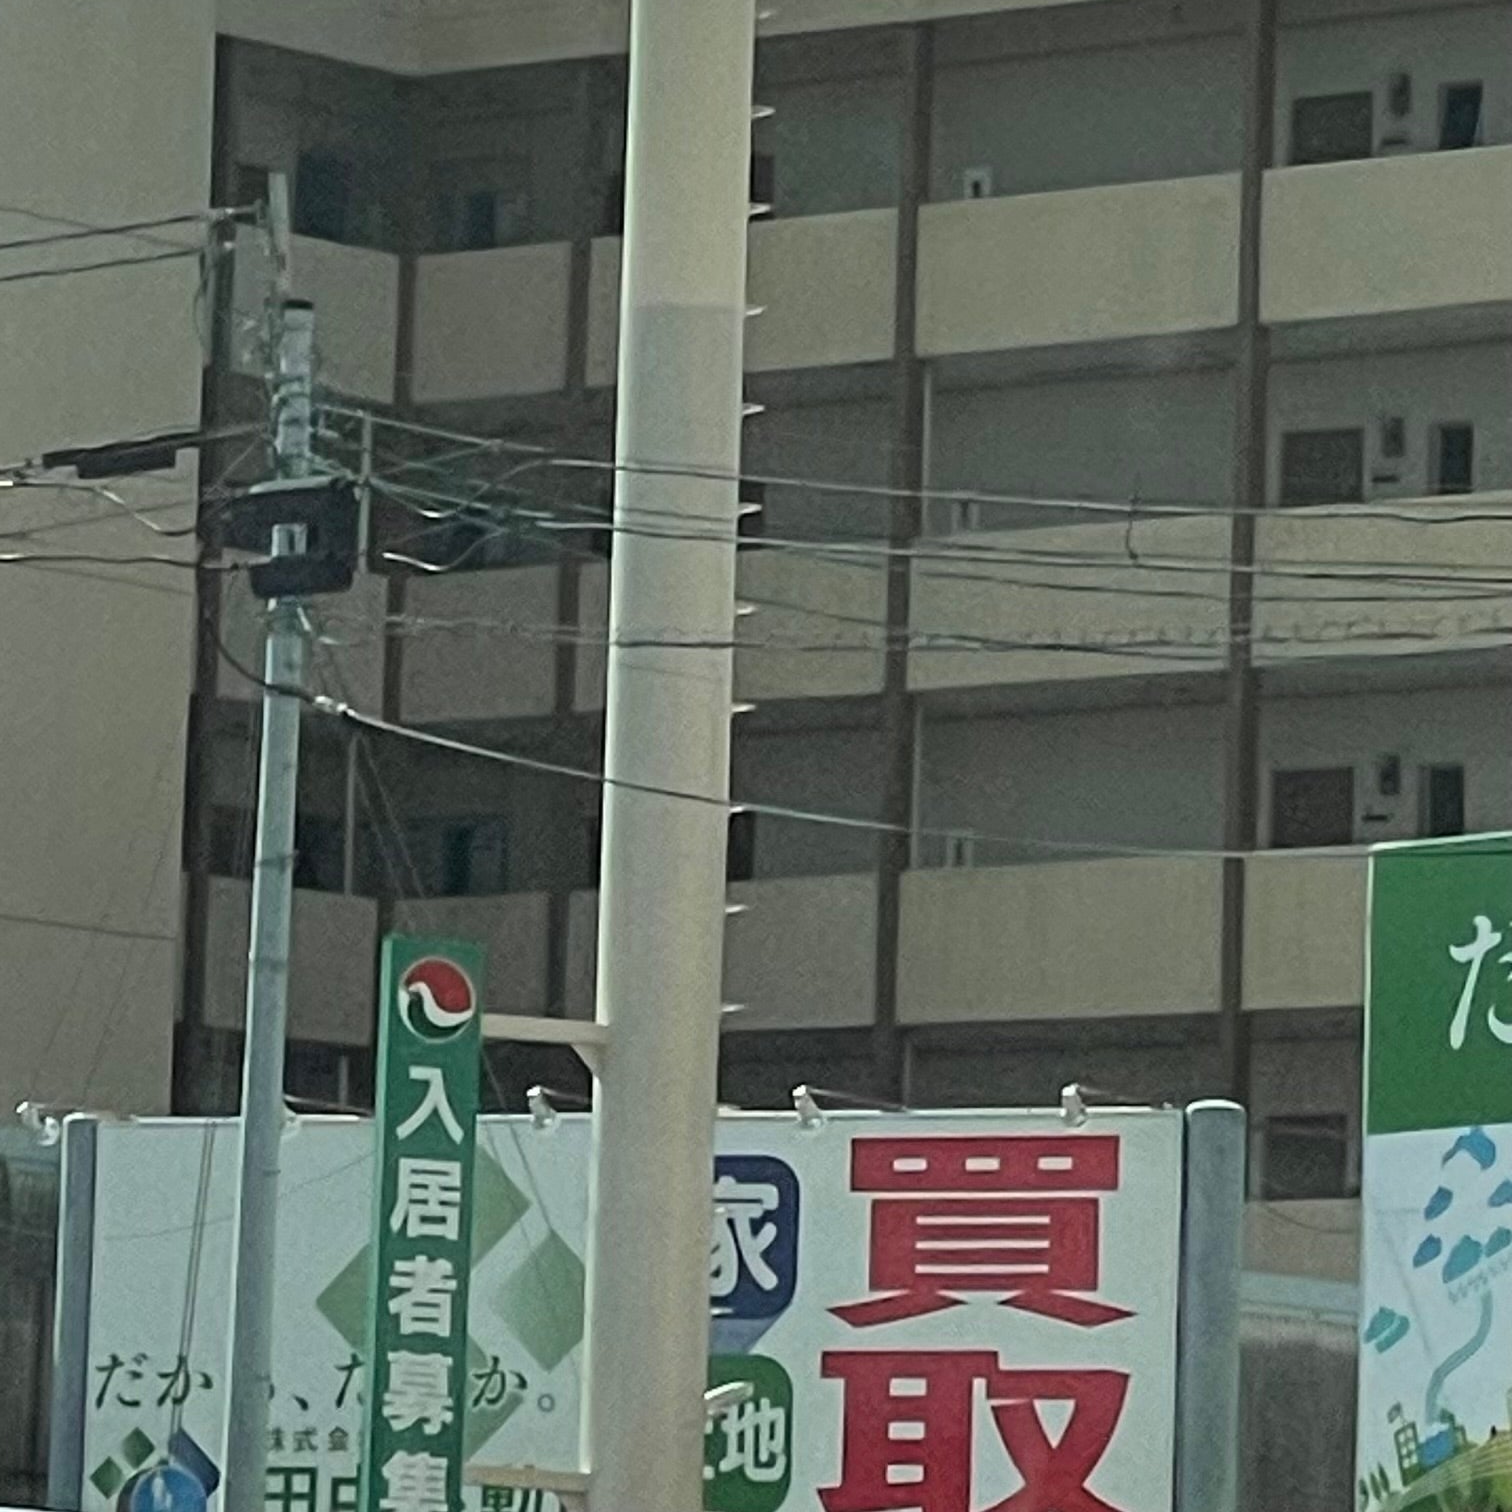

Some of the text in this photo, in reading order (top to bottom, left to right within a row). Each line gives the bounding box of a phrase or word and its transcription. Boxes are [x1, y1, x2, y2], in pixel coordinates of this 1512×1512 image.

[379, 1064, 465, 1512] 入居者募集
[816, 1135, 1140, 1512] 買取
